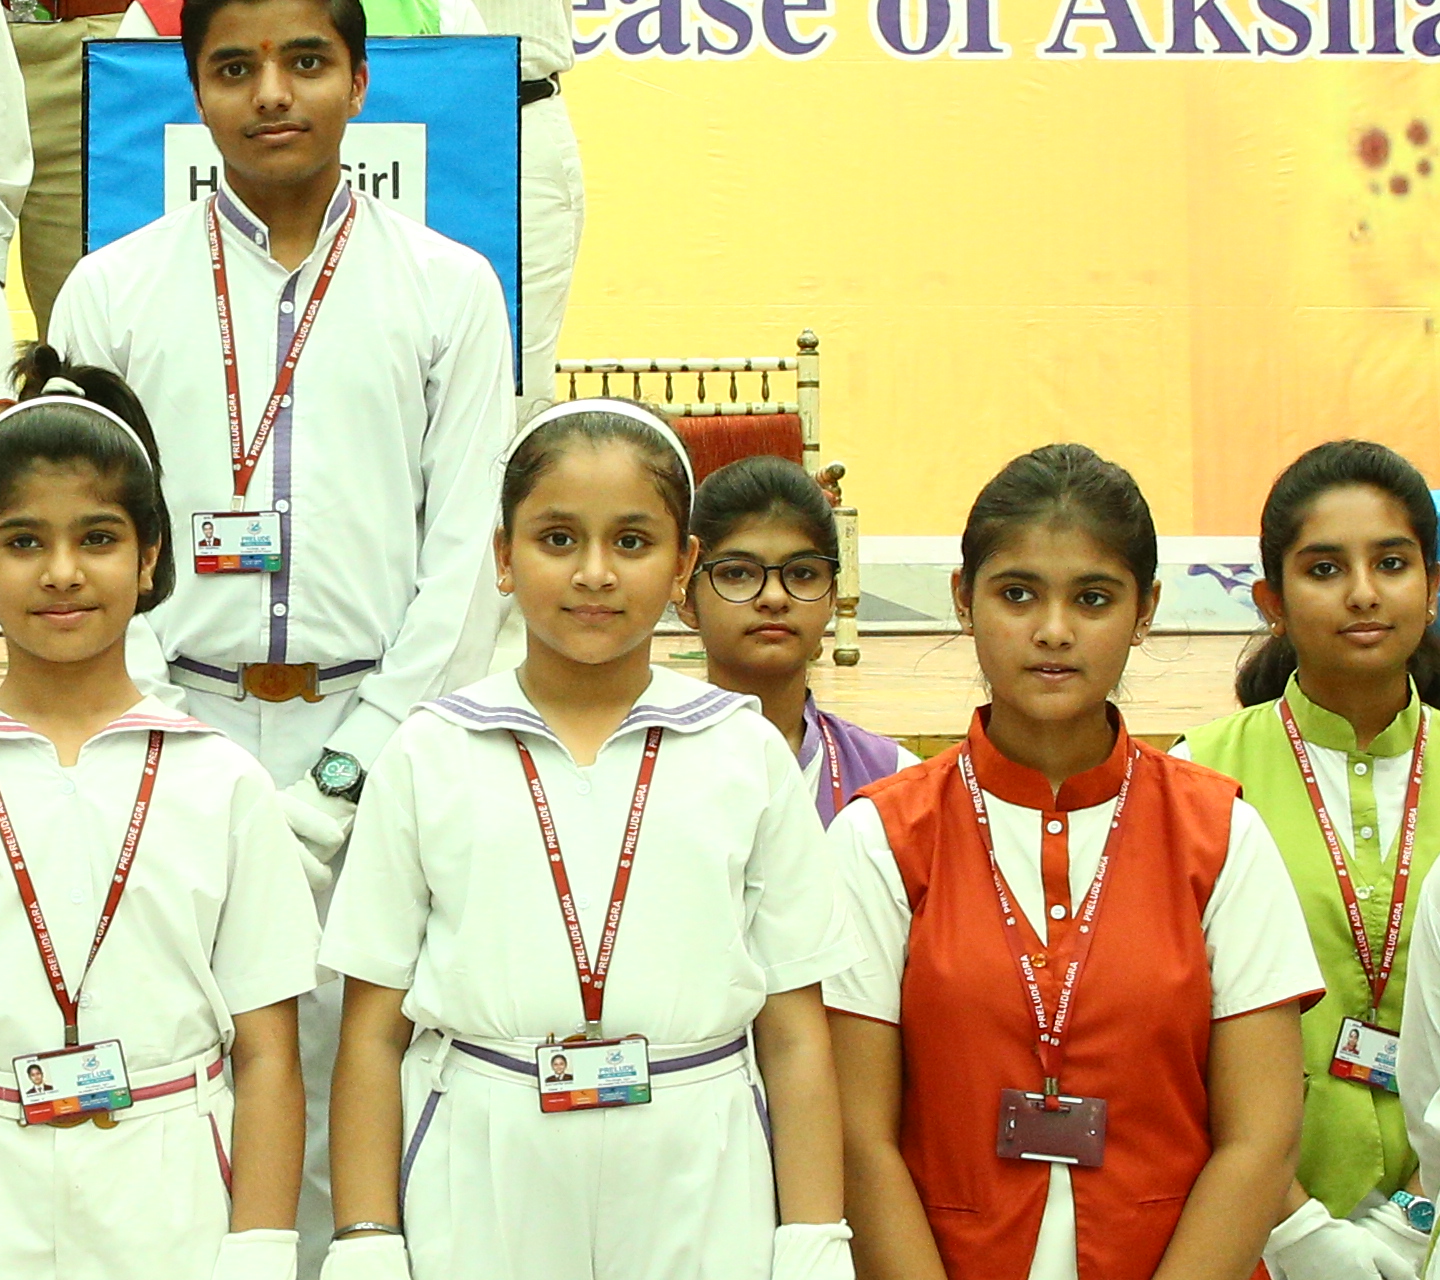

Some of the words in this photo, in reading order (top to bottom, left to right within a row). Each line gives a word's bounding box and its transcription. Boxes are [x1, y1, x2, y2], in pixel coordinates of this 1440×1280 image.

[218, 294, 226, 315] AGRA
[220, 317, 231, 355] PRELUDE
[290, 322, 312, 360] PRELUDE
[306, 298, 321, 322] AGRA
[228, 393, 237, 417] AGRA
[250, 418, 273, 457] PRELUDE
[267, 393, 282, 417] AGRA
[230, 420, 240, 459] PRELUDE
[532, 777, 546, 803] AGRA
[118, 828, 139, 872] PRELUDE
[132, 800, 146, 827] AGRA
[539, 805, 556, 850] PRELUDE
[624, 810, 643, 856] PRELUDE
[635, 783, 649, 809] AGRA
[1408, 807, 1418, 826] AGRA
[1402, 828, 1415, 866] PRELUDE
[29, 901, 46, 931] AGRA
[561, 892, 575, 918] AGRA
[39, 931, 61, 980] PRELUDE
[568, 919, 587, 970] PRELUDE
[597, 927, 616, 977] PRELUDE
[609, 900, 623, 926] AGRA
[1381, 927, 1398, 969] PRELUDE
[1391, 901, 1404, 926] AGRA
[1021, 953, 1036, 980] AGRA
[1028, 982, 1047, 1030] PRELUDE
[1054, 987, 1073, 1034] PRELUDE
[1066, 960, 1080, 986] AGRA
